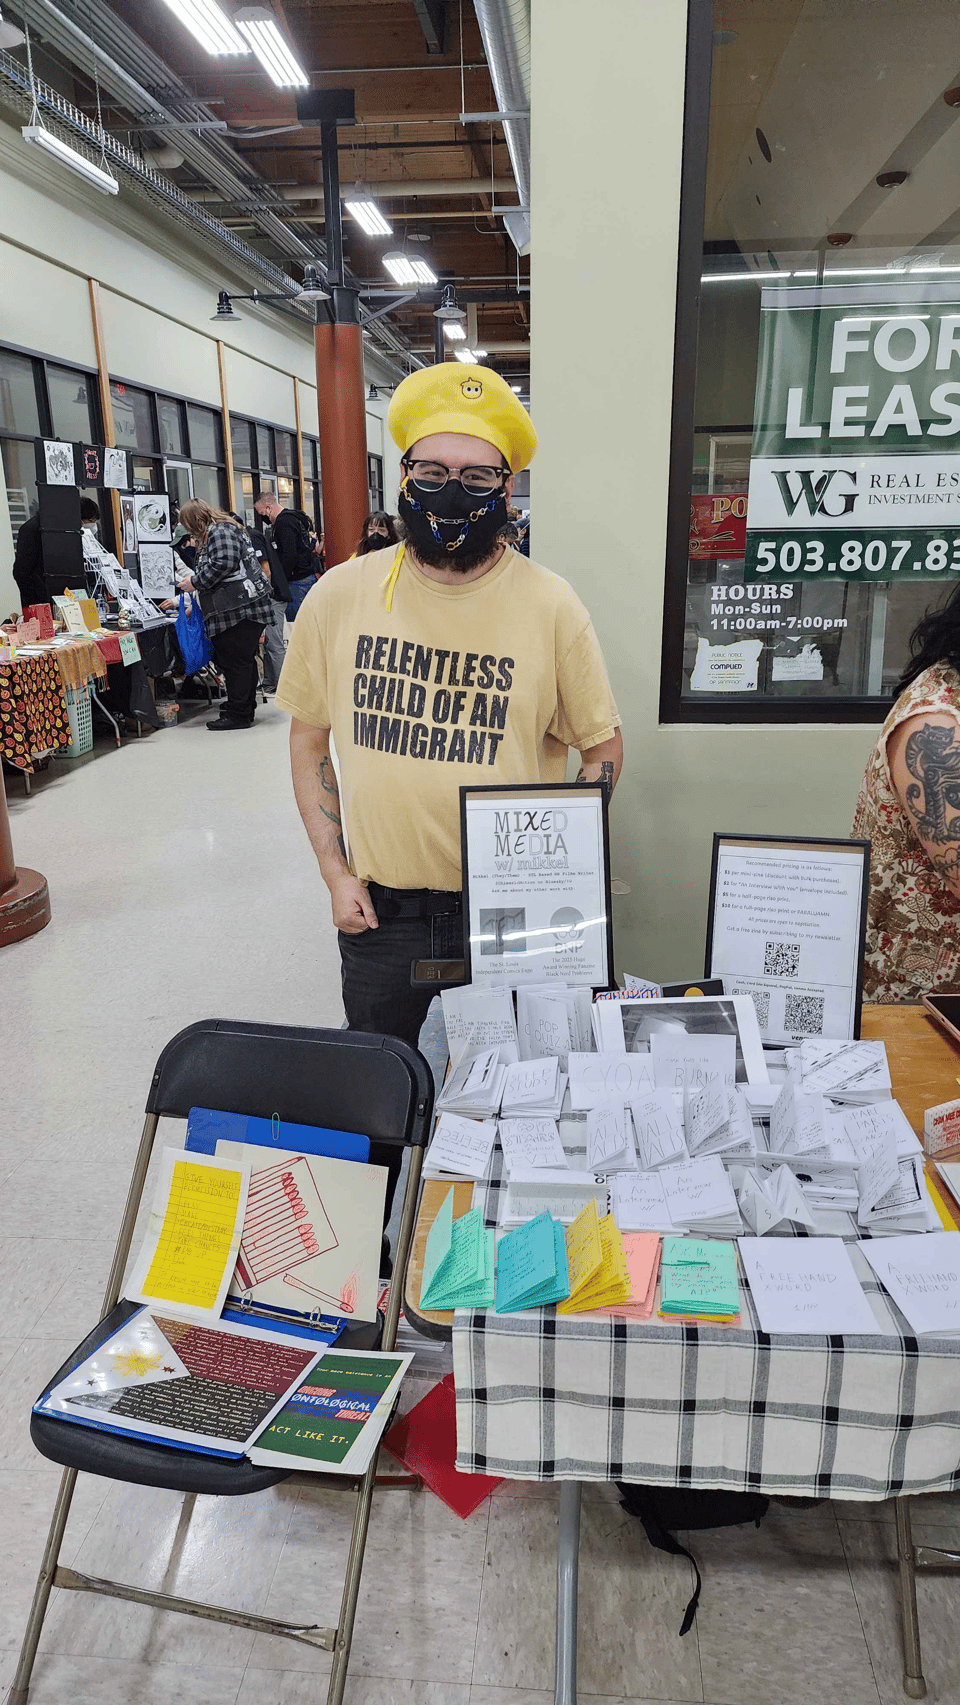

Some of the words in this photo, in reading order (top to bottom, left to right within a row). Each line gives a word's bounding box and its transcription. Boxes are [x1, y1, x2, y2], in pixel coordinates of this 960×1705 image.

[830, 318, 960, 373] FOR
[870, 474, 926, 488] REAL
[868, 493, 954, 504] INVESTMENT
[710, 584, 794, 600] HOURS
[710, 603, 781, 614] Mon-Sun
[710, 617, 848, 630] 11:00am-7:00pm
[355, 634, 515, 692] RELENTLESS
[354, 672, 427, 719] CHILD
[432, 688, 467, 724] OF
[469, 692, 509, 730] AN
[354, 711, 504, 766] IMMIGRANT
[494, 810, 568, 834] MIXED
[494, 833, 568, 857] MEDIA
[495, 857, 514, 872] w/
[517, 856, 569, 871] mikkel
[540, 1019, 558, 1034] POP
[535, 1030, 560, 1048] QUIZ
[509, 1076, 550, 1093] STUDY
[760, 1273, 837, 1283] FREEHAND
[269, 1425, 291, 1434] ACT
[295, 1430, 324, 1440] LIKE
[330, 1435, 349, 1444] IT.
